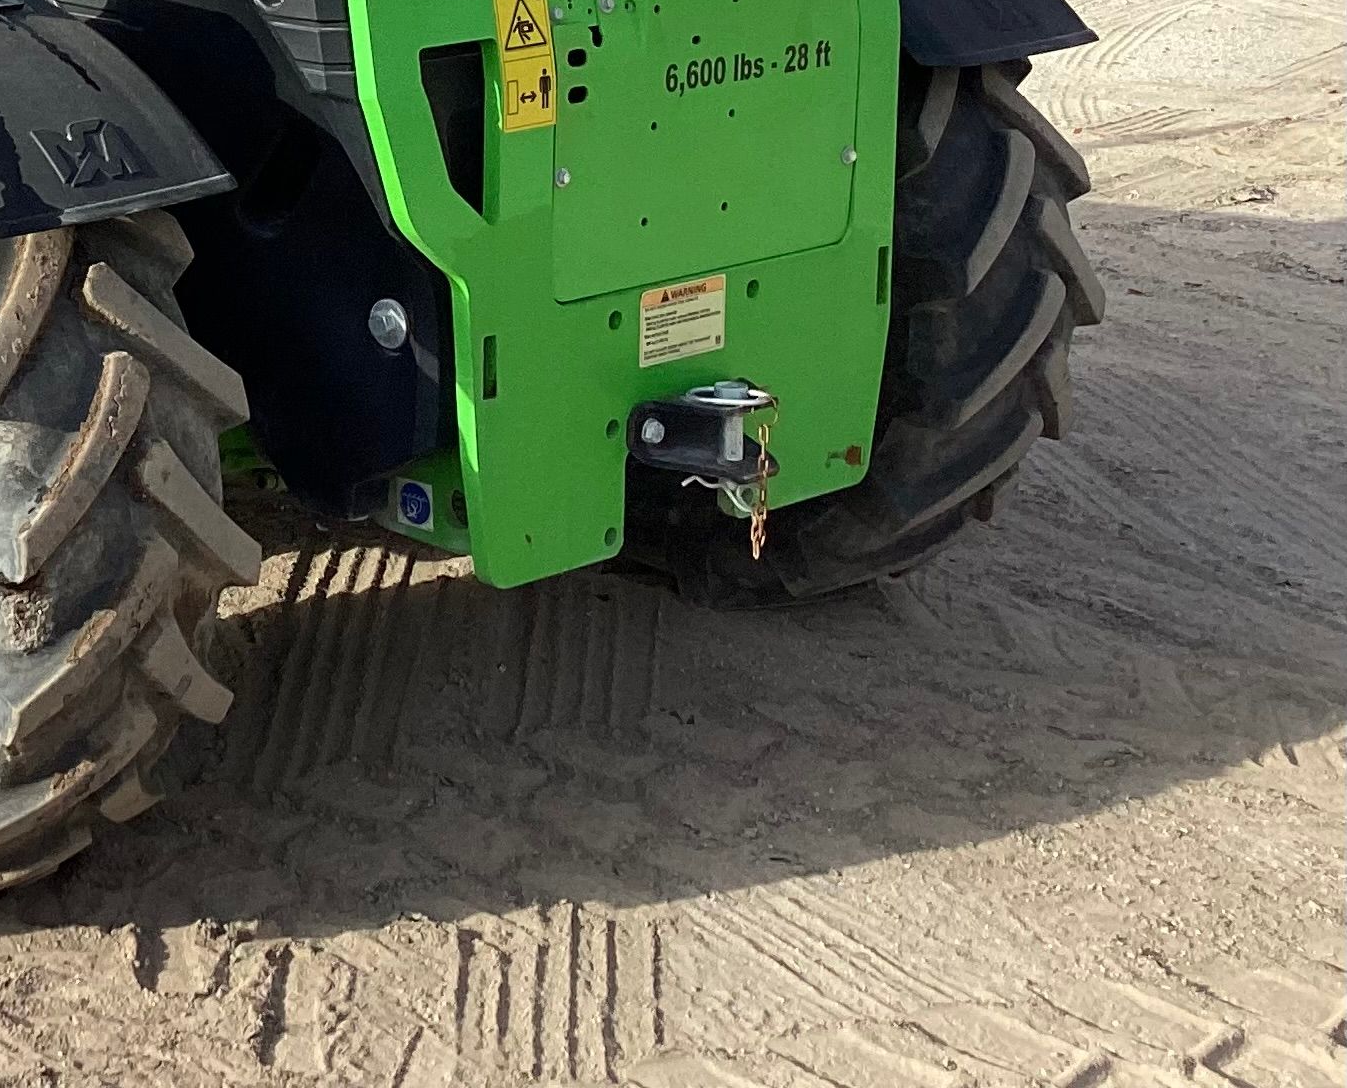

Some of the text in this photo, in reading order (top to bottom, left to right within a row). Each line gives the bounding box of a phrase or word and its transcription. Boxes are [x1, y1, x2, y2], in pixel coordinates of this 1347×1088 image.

[665, 56, 726, 97] 6,600
[733, 52, 765, 82] lbs
[783, 42, 809, 73] 28
[815, 39, 831, 69] ft
[670, 282, 707, 300] WARNING
